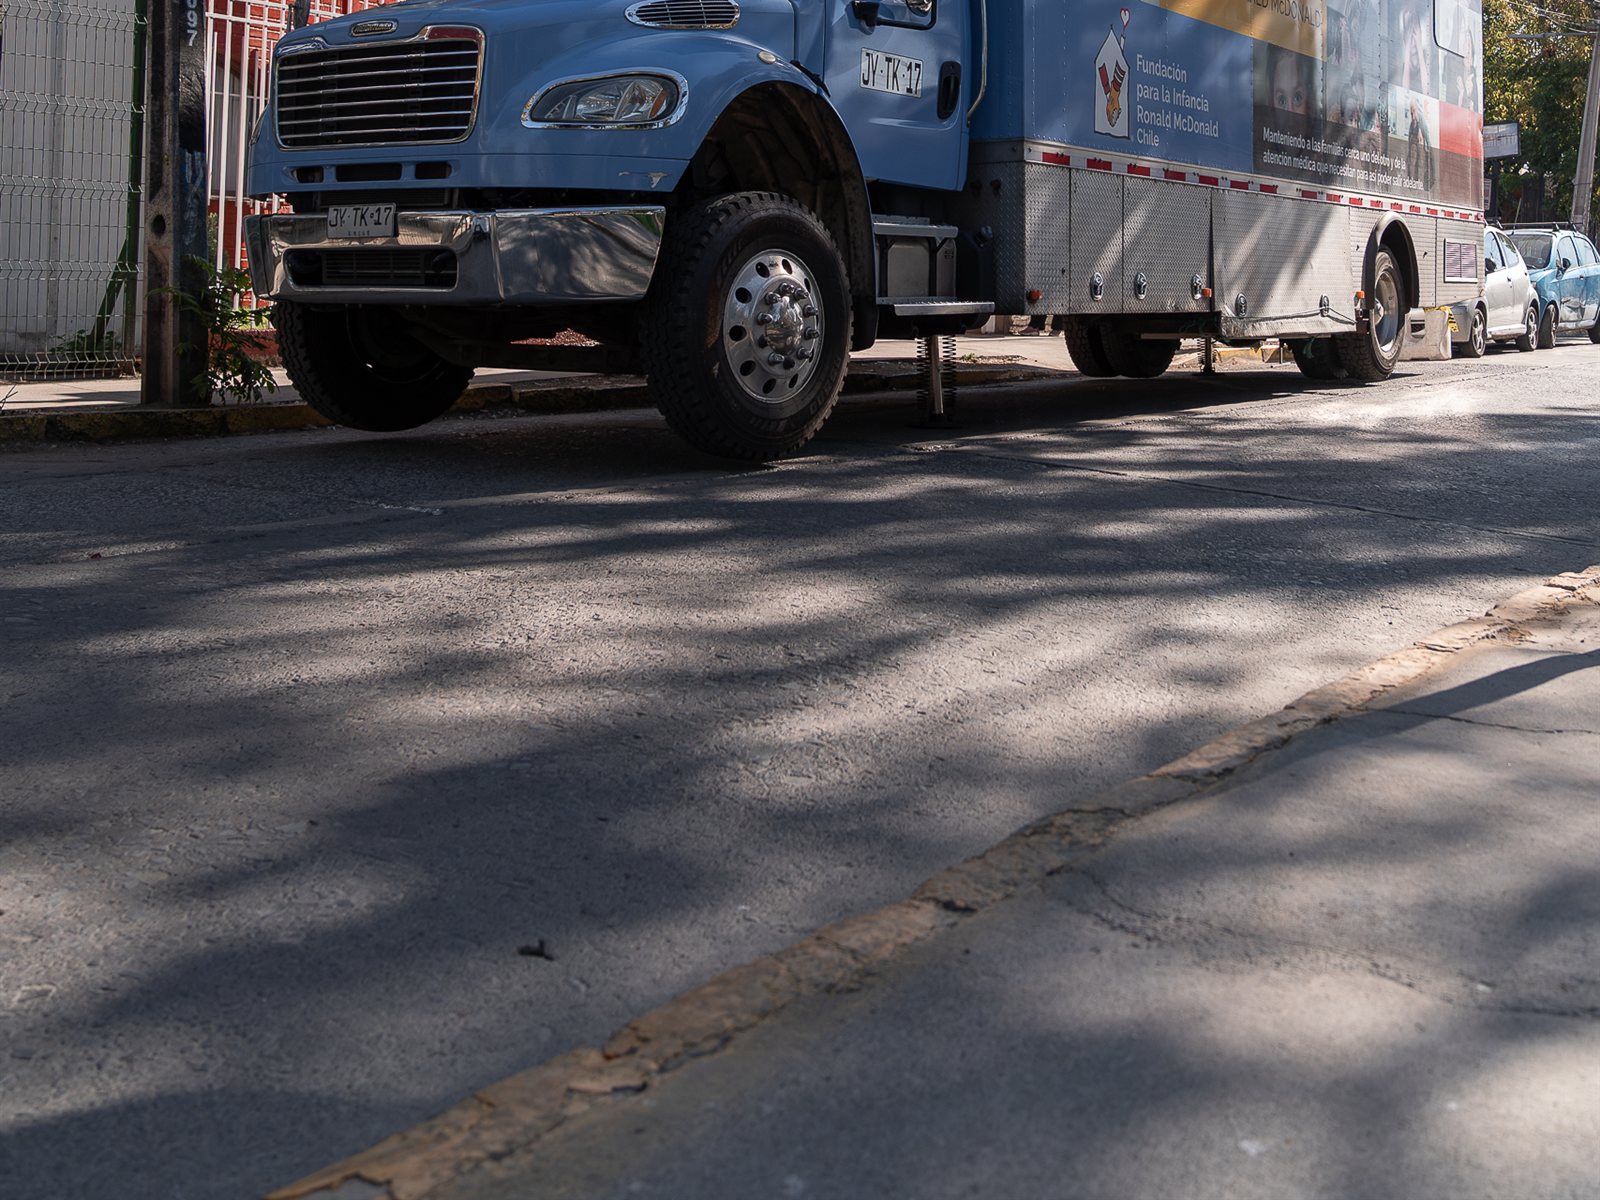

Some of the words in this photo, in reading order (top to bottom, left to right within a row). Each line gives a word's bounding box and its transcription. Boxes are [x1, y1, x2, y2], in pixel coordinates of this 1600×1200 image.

[1136, 54, 1187, 83] Fundación
[1137, 83, 1160, 102] para
[1162, 85, 1171, 103] la
[1173, 87, 1209, 113] Infancia
[1137, 105, 1171, 128] Ronald
[1174, 116, 1219, 138] McDonald
[1136, 130, 1160, 147] Chile
[1263, 127, 1306, 149] Manteniendo
[1312, 137, 1321, 153] las
[1321, 139, 1344, 157] familias
[1344, 147, 1359, 160] cerca
[1360, 151, 1370, 162] uno
[1371, 151, 1380, 164] del
[1263, 148, 1292, 167] atención
[1293, 155, 1316, 171] médica
[1316, 162, 1328, 176] que
[1329, 163, 1356, 178] necesitan
[1356, 168, 1368, 182] para
[1378, 172, 1392, 185] poder
